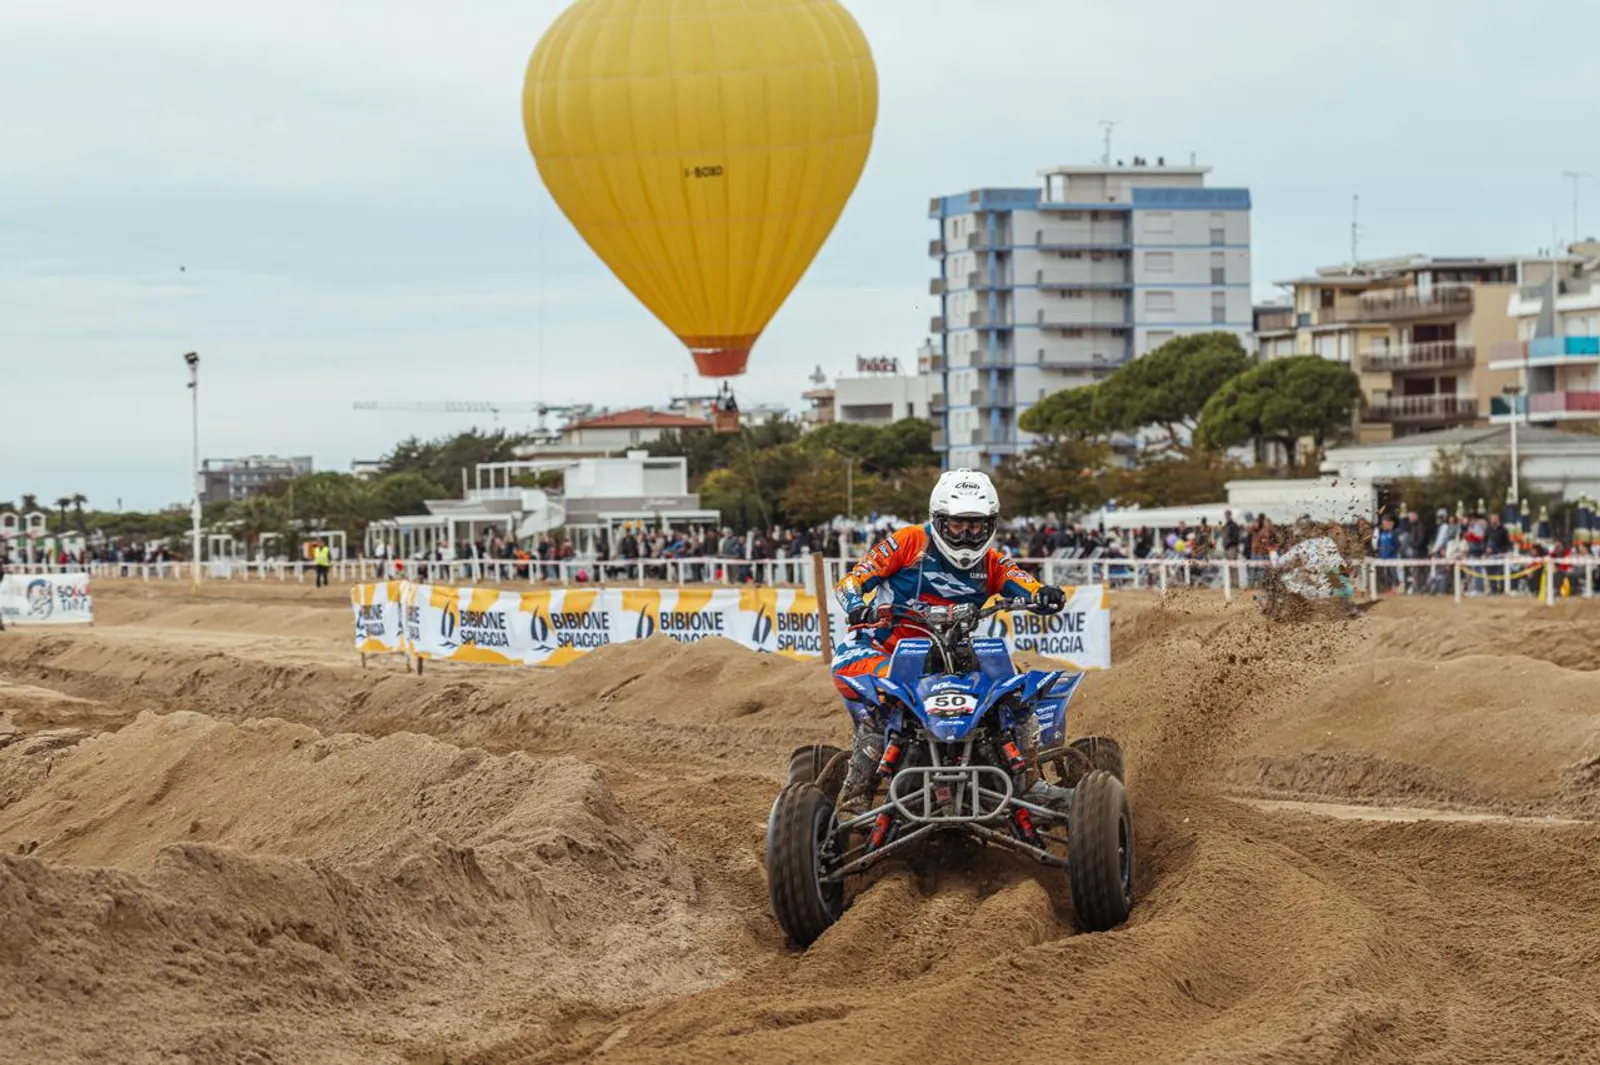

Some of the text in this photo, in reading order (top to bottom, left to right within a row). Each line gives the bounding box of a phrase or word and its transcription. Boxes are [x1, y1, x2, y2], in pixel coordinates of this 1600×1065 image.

[459, 610, 506, 630] BIBIONE
[551, 611, 610, 630] BIBIONE
[660, 611, 724, 631] BIBIONE
[1012, 612, 1086, 635] BIBIONE
[460, 629, 510, 648] SPIAGGIA
[557, 631, 610, 648] SPIAGGIA
[777, 633, 837, 652] SPIAGGA
[1014, 635, 1084, 655] SPIAGGIA
[935, 696, 967, 707] 50
